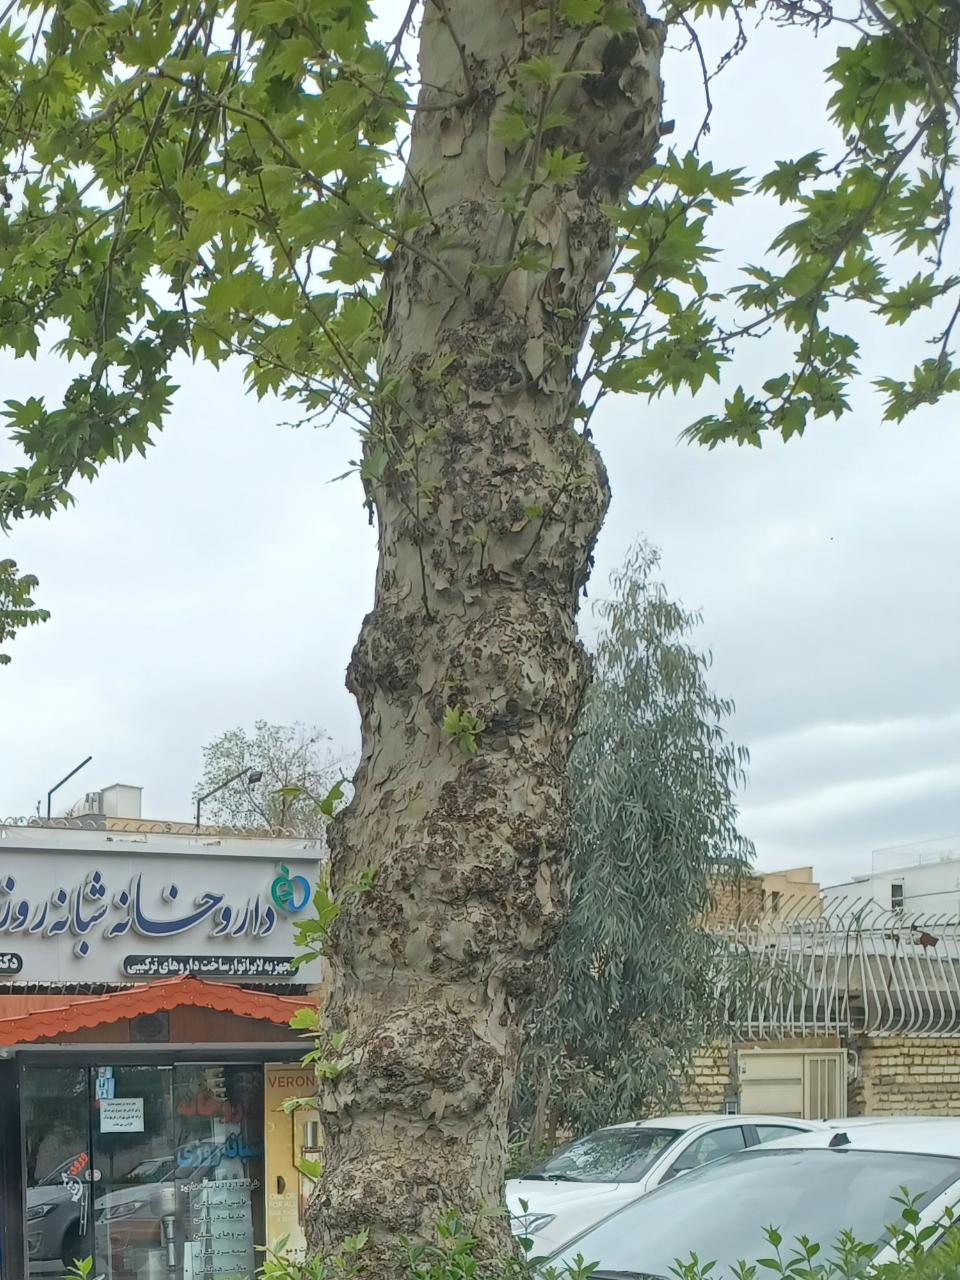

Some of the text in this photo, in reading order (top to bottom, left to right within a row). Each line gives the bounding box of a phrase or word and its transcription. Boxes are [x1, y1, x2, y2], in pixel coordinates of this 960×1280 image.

[47, 869, 111, 959] شبانه
[105, 872, 277, 938] داروخانه
[126, 957, 296, 975] جهز به لابراتوار ساخت داروهای ترکیبی
[268, 1075, 318, 1088] VERON
[176, 1092, 257, 1124] اروخانه
